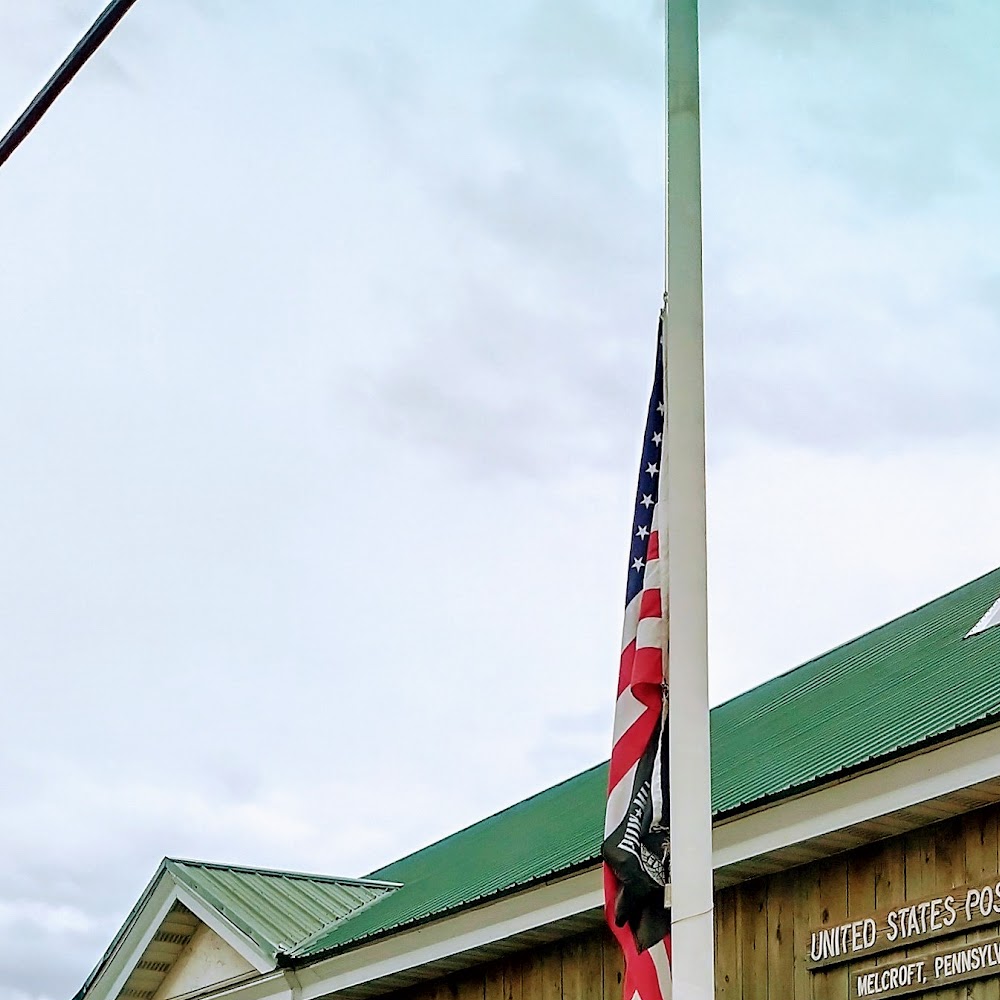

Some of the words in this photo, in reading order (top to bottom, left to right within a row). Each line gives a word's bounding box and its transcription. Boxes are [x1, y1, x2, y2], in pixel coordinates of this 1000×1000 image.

[810, 918, 876, 961] UNITED
[886, 896, 956, 941] STATES
[857, 962, 927, 998] MELCROFT,
